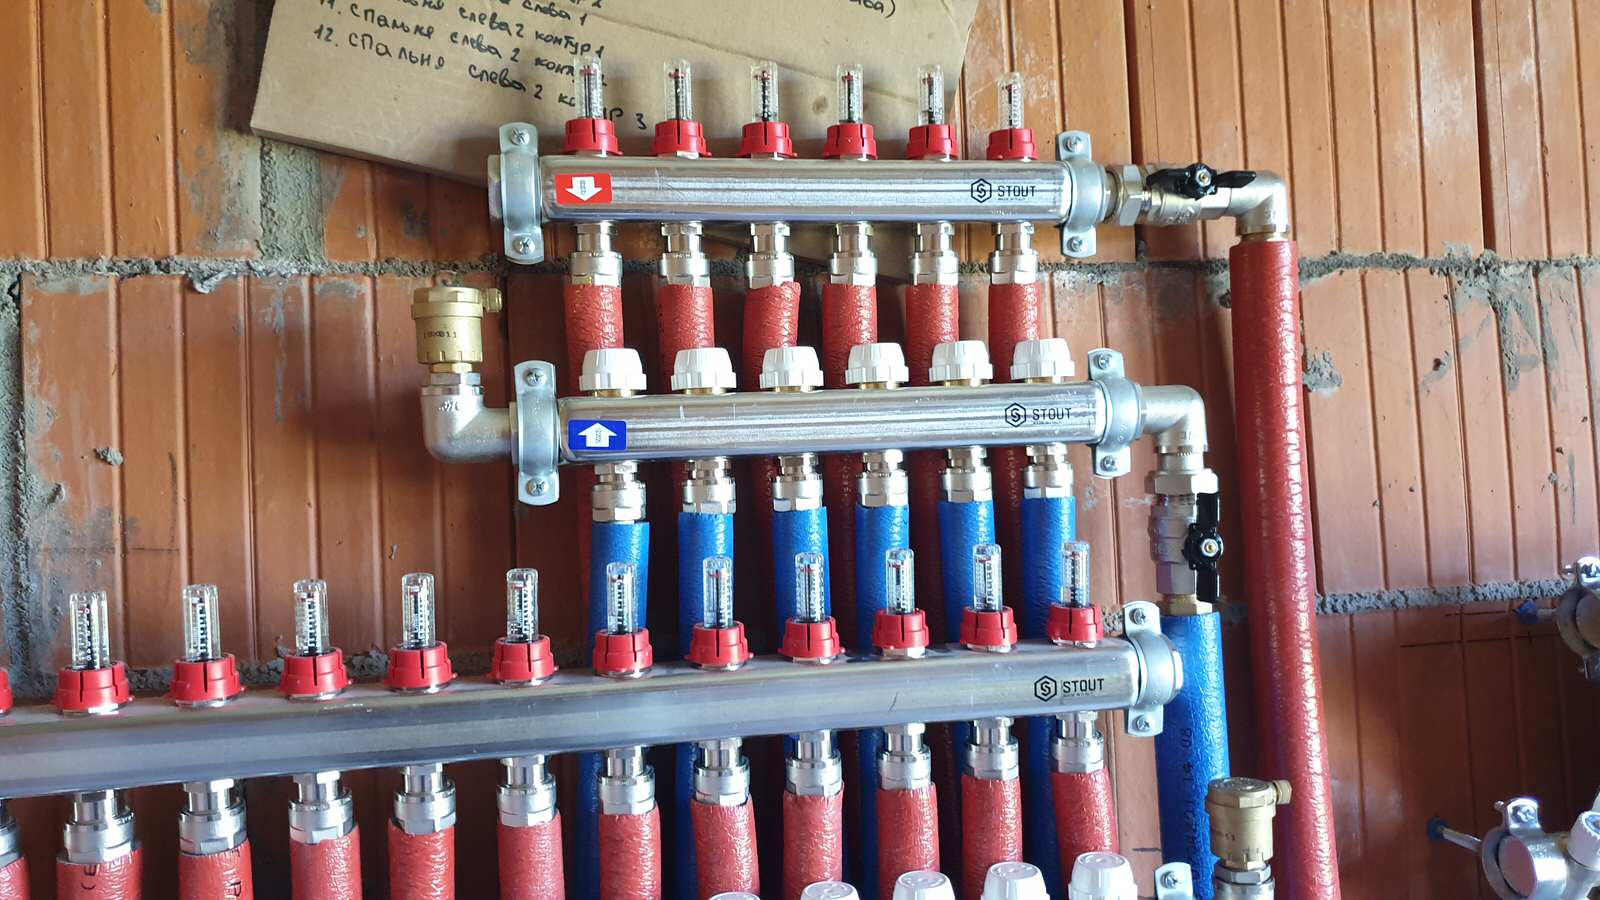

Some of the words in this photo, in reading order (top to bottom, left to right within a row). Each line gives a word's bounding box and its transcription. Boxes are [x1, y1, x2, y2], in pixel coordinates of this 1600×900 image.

[580, 13, 588, 26] 1
[458, 7, 512, 37] слева
[516, 23, 525, 38] 2
[535, 31, 592, 56] контур
[450, 32, 502, 59] слева
[510, 47, 521, 63] 2
[313, 24, 339, 47] 12.
[468, 64, 527, 92] слева
[534, 84, 544, 100] 2
[635, 113, 647, 130] 3
[997, 185, 1037, 198] STOUT
[1032, 407, 1072, 421] STOUT
[1062, 678, 1105, 694] STOUT
